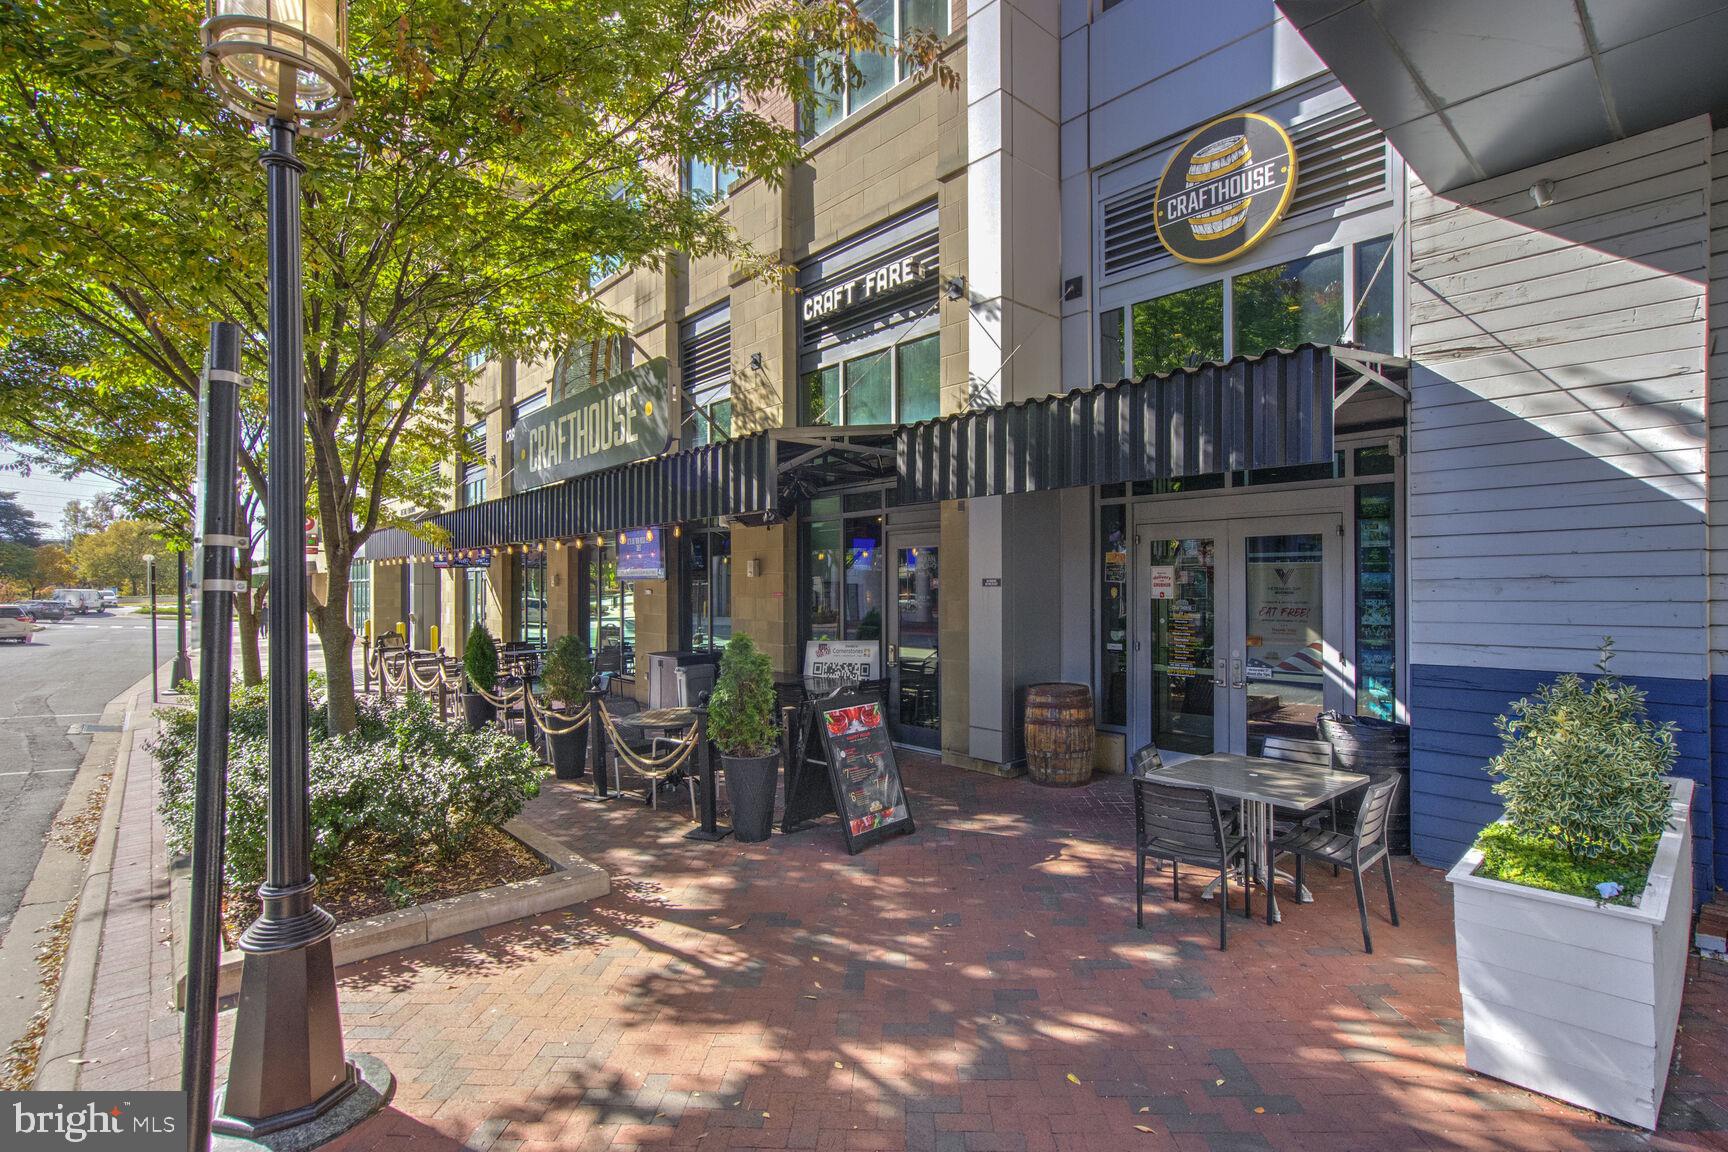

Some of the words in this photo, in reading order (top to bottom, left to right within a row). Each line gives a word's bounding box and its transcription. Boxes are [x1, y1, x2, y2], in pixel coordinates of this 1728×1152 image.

[1167, 163, 1275, 220] CRAFTHOUSE
[803, 281, 855, 321] CRAFT
[865, 257, 914, 297] FARE
[529, 385, 639, 473] CRAFTHOUSE
[1259, 606, 1278, 617] EAT
[1280, 606, 1311, 619] FREE!
